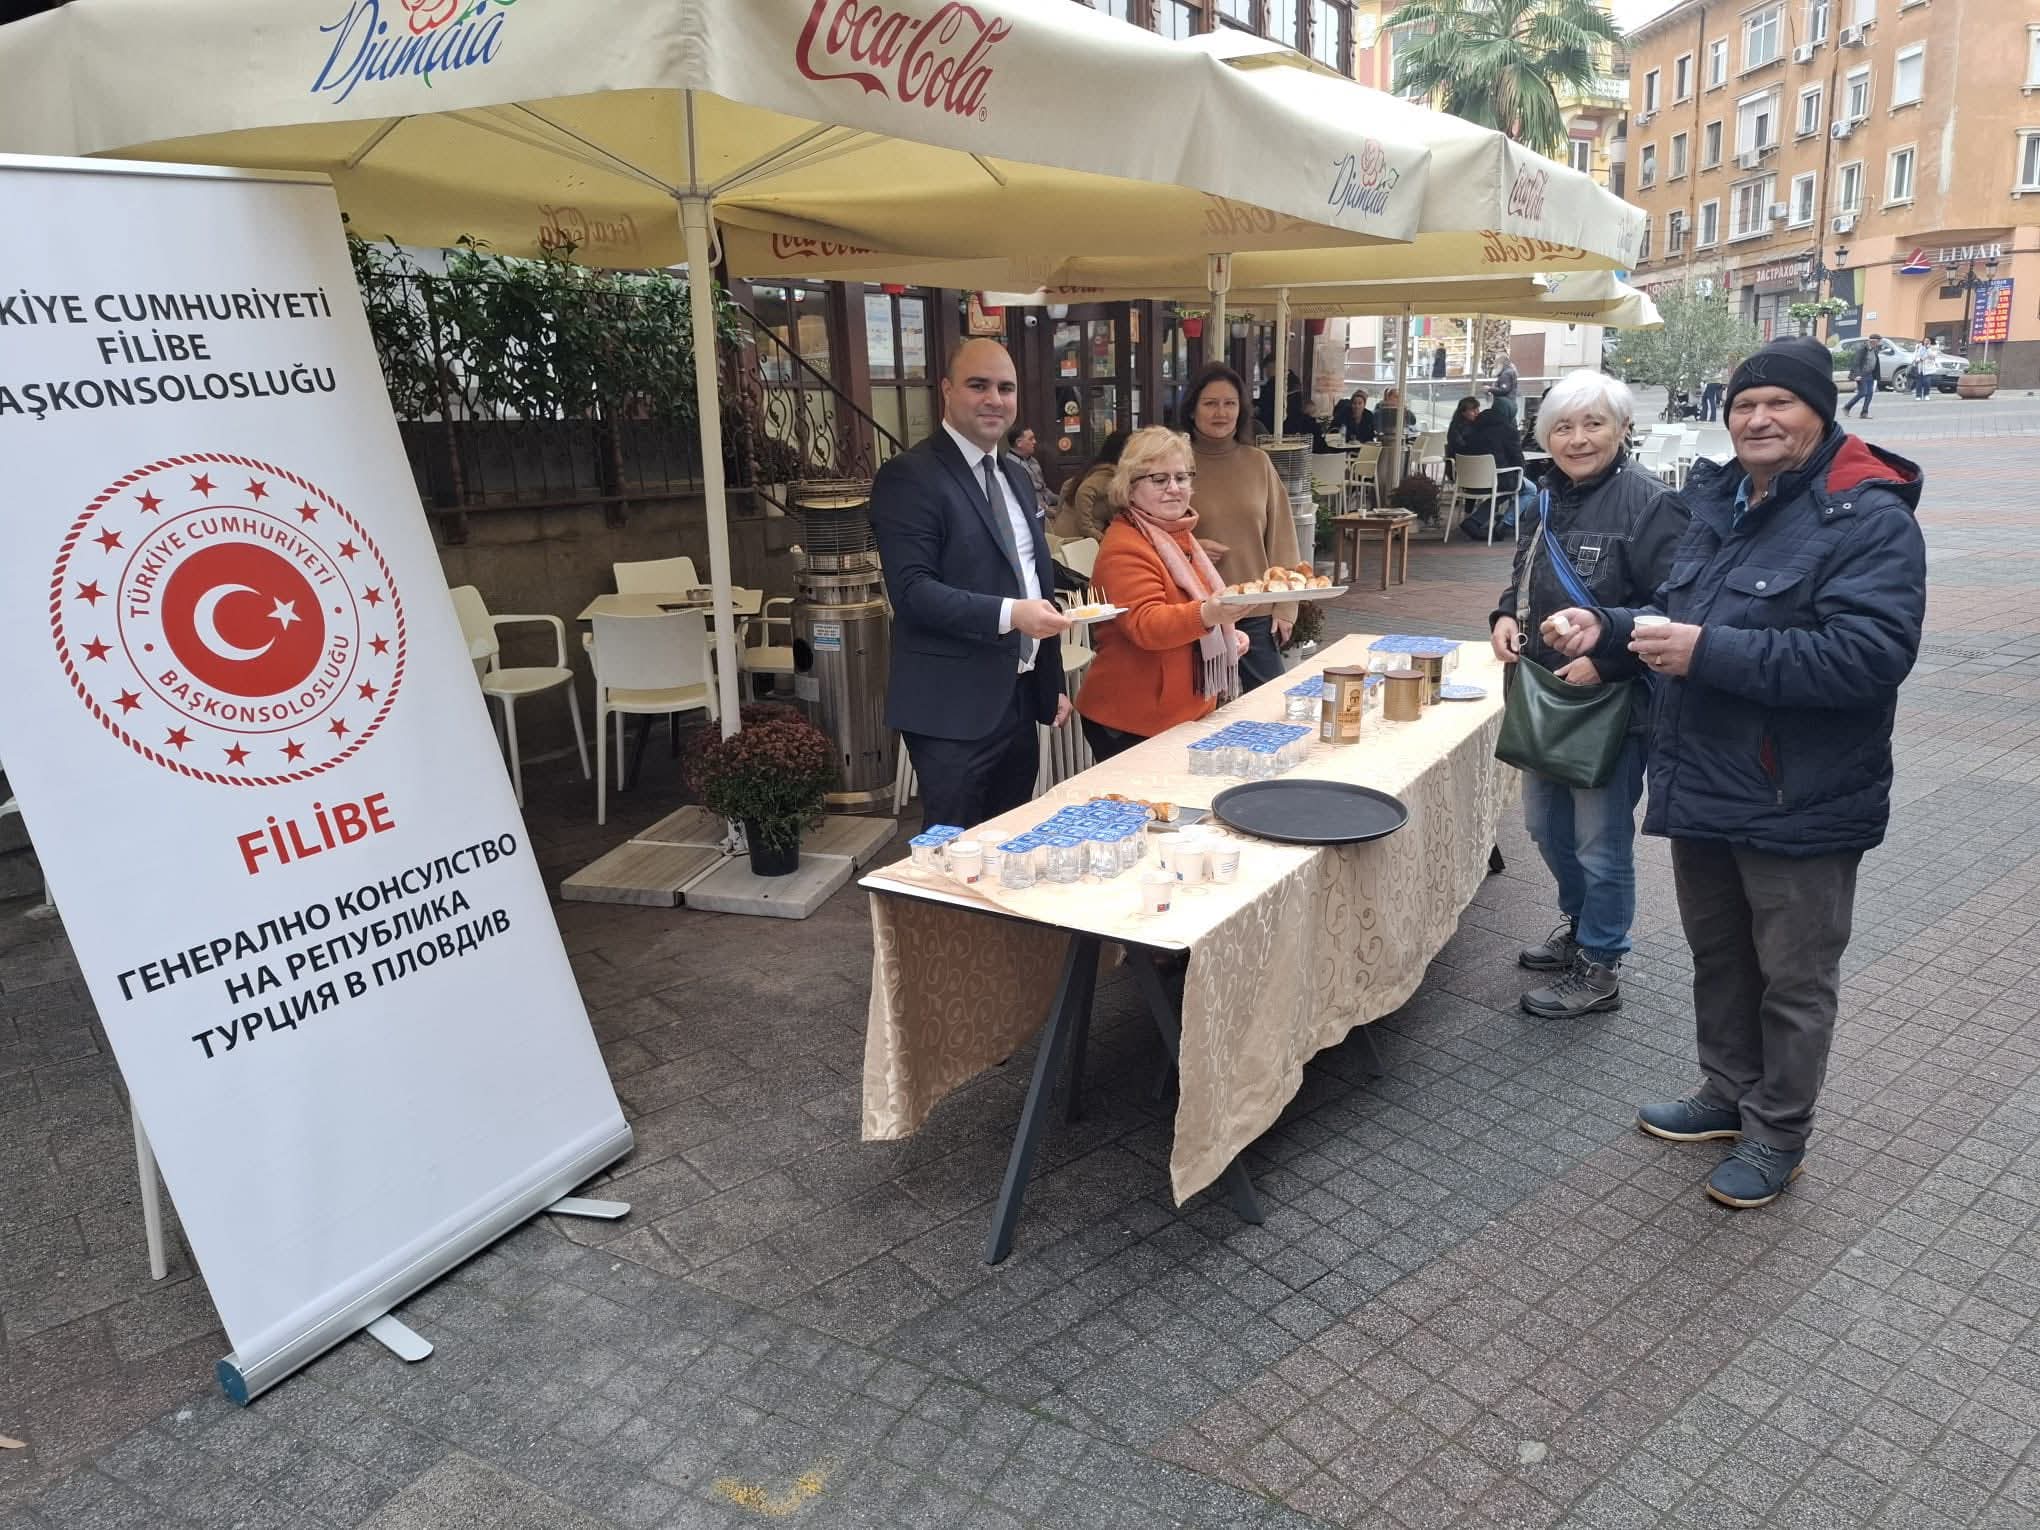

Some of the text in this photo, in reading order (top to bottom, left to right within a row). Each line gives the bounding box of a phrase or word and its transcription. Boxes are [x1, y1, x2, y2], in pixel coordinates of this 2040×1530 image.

[796, 0, 1013, 117] Coca-Cola
[1756, 261, 1811, 283] ЗАСТРАХО
[1938, 243, 2001, 262] LIMAR
[94, 287, 332, 323] CUMHURİYETİ
[96, 328, 211, 365] FİLİBE
[127, 516, 337, 618] TÜRKİYE CUMHURİYETİ
[158, 634, 350, 724] BAŞKONSOLOSLUĞU
[236, 792, 396, 875] FİLİBE
[116, 833, 518, 1001] ГЕНЕРАЛНО КОНСУЛСТВО
[224, 889, 471, 1005] НА РЕПУБЛИКА
[191, 909, 511, 1059] ТУРЦИЯ В ПЛОВДИВ
